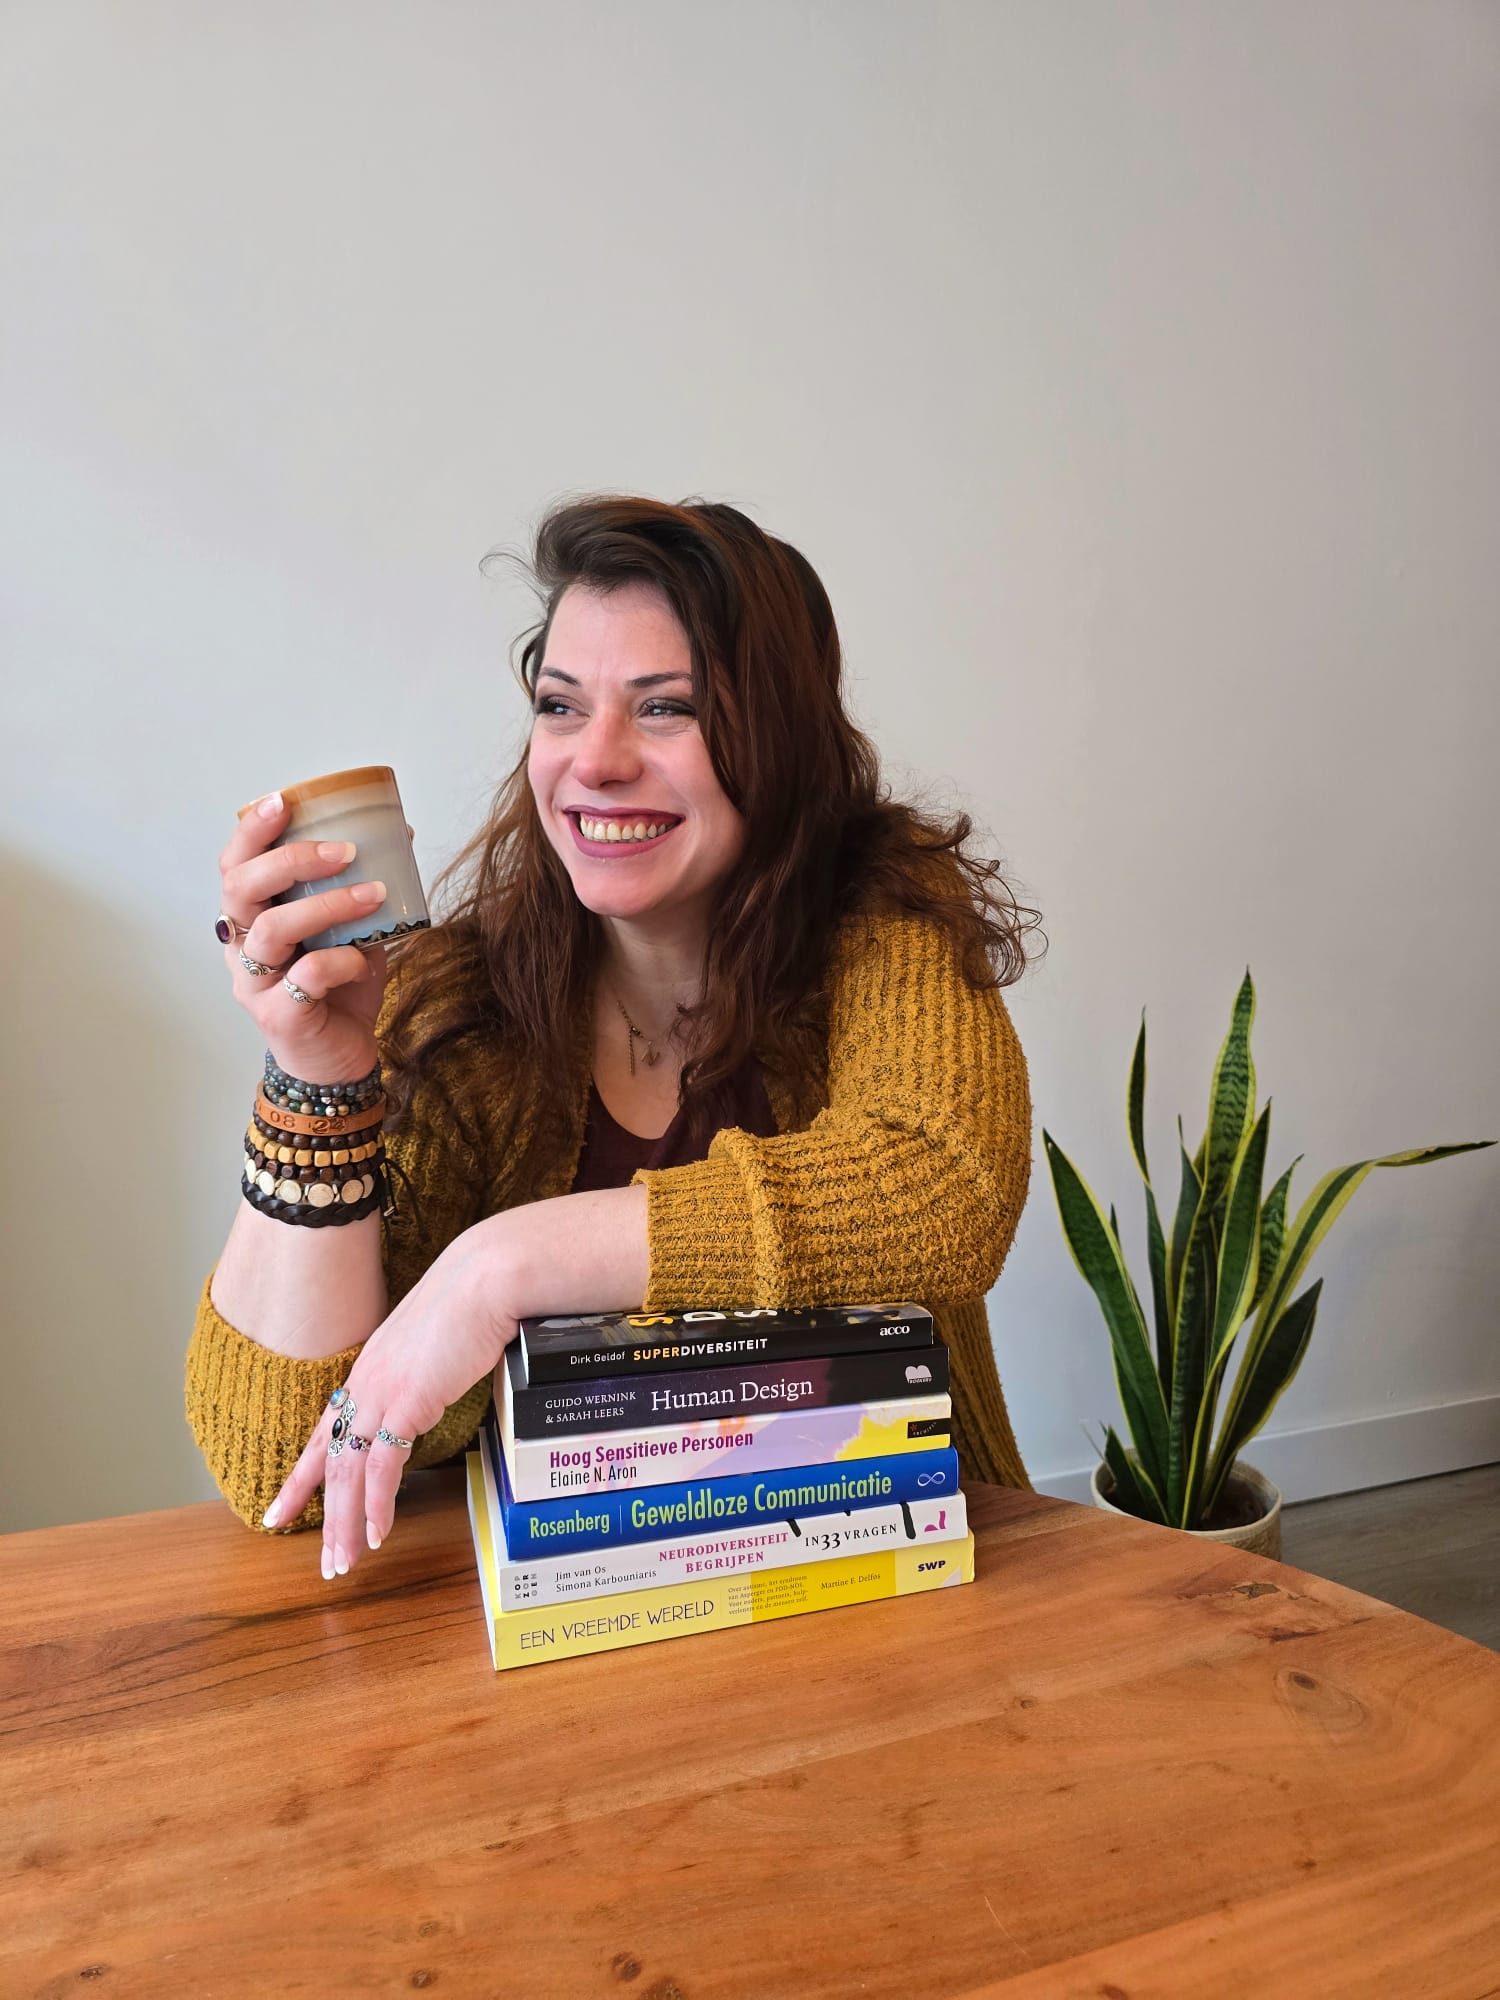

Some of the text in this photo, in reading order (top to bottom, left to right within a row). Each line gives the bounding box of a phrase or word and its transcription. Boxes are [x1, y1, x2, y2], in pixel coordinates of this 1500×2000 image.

[879, 1325, 911, 1336] acco
[570, 1338, 768, 1365] Dirk Geldof SUPERDIVERSITEIT
[545, 1391, 637, 1409] GUIDO WERNINK
[650, 1378, 815, 1411] Human Design
[545, 1407, 625, 1424] & SARAH LEERS
[550, 1432, 753, 1469] Hoog Sensitieve Personen
[550, 1464, 637, 1488] Elaine N. Aron
[631, 1470, 892, 1529] Geweldloze Communicatie
[530, 1509, 610, 1539] Rosenberg
[658, 1532, 789, 1562] NEURODIVERSITEIT
[805, 1523, 897, 1551] IN 33 VRAGEN
[554, 1565, 606, 1582] Jim van Os
[686, 1551, 764, 1574] BEGRIJPEN
[917, 1560, 946, 1572] SWP
[556, 1569, 657, 1593] Simona Karbouniaris
[820, 1579, 849, 1590] Martine
[858, 1572, 881, 1583] Delfos
[520, 1599, 714, 1650] EEN VREEMDE WERELD
